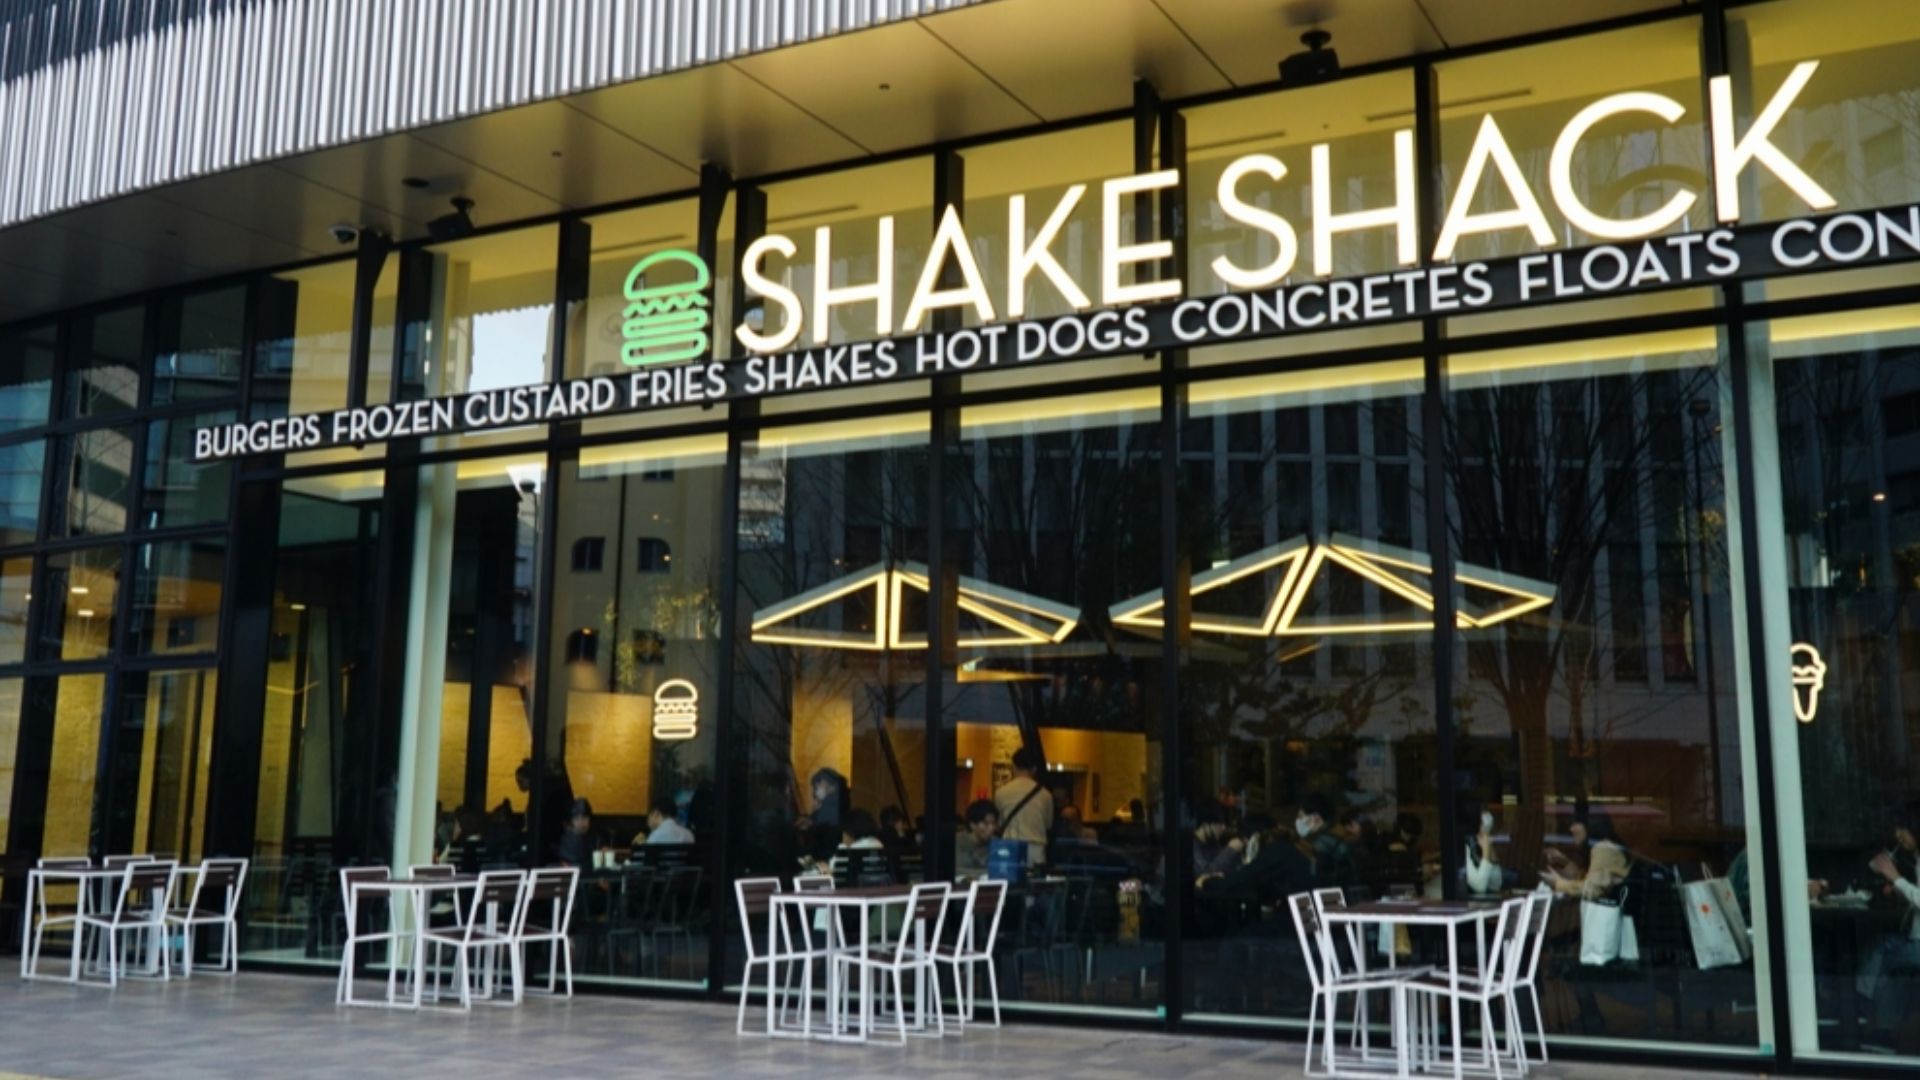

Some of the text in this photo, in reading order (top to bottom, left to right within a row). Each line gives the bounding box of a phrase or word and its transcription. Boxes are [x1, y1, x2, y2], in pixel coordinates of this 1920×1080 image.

[195, 206, 1920, 459] BURGERS FROZEN CUSTARD FRIES SHAKES HOT DOGS CONCRETES FLOATS CON
[735, 60, 1838, 352] SHAKE SHACK
